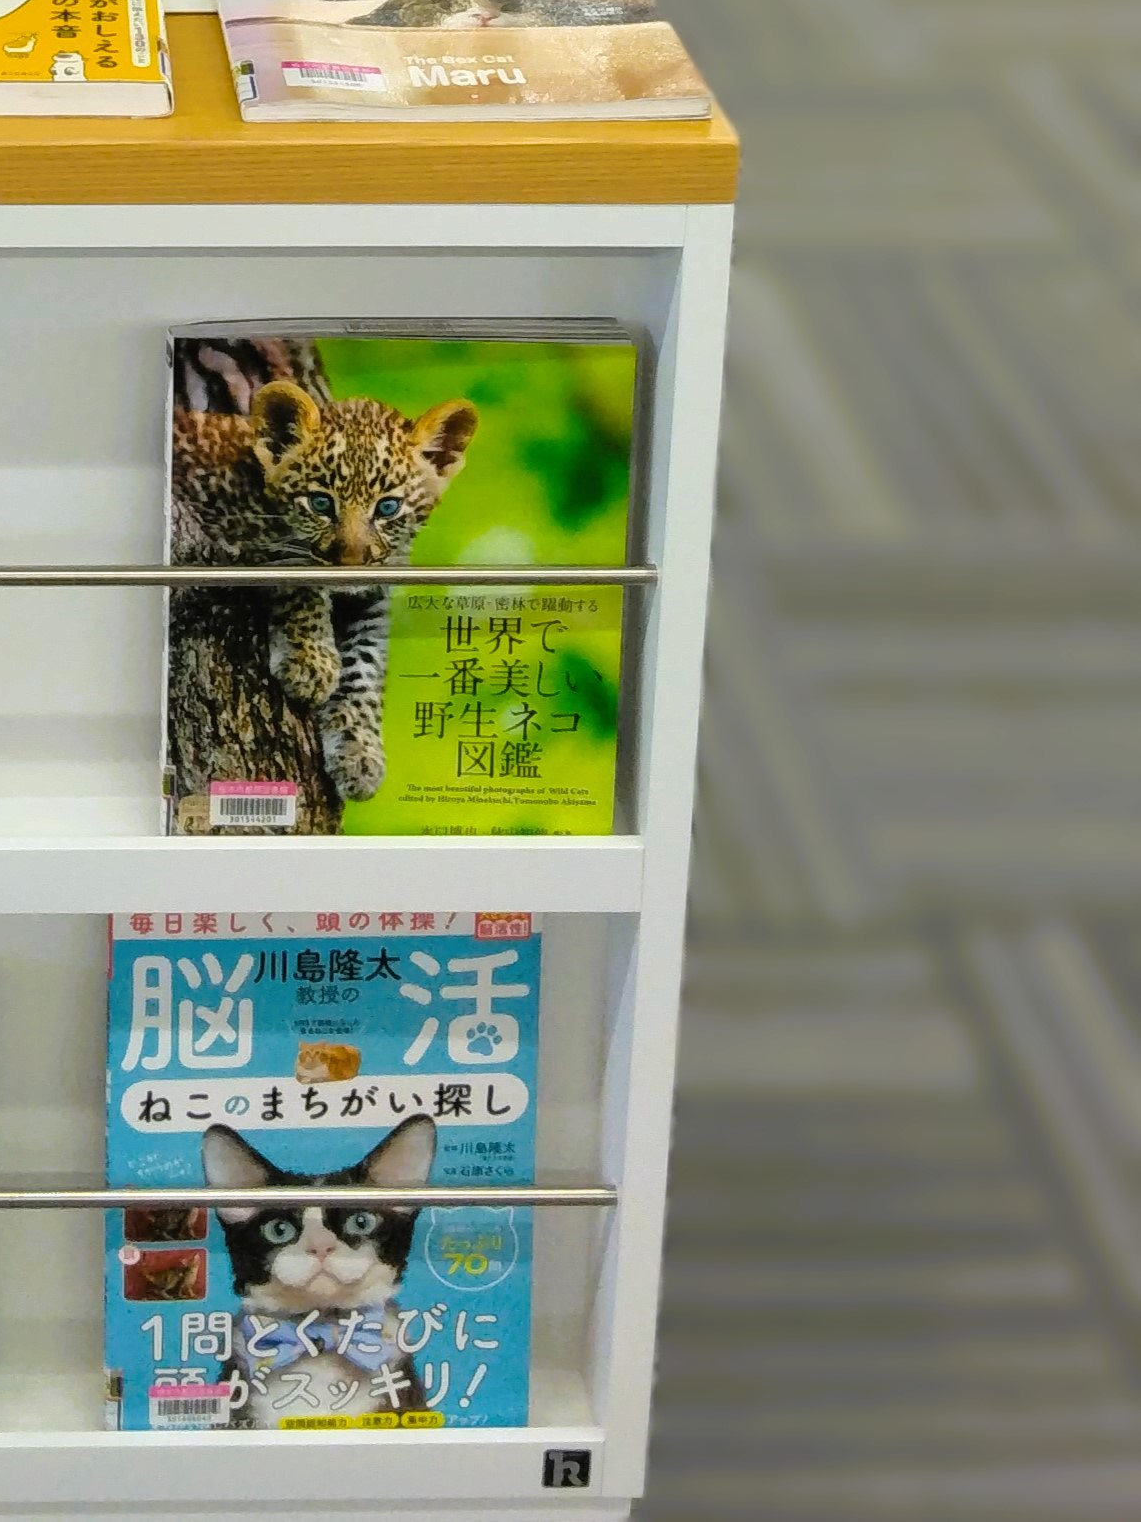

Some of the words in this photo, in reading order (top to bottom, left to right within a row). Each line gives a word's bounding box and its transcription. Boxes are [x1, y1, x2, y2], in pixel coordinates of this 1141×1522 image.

[402, 56, 437, 65] The
[481, 55, 515, 63] Cat
[408, 65, 527, 87] Maru
[440, 615, 569, 654] 世界で
[399, 657, 603, 698] 一番美しい
[414, 701, 581, 741] 野生ネコ
[457, 741, 543, 779] 図鑑
[254, 948, 403, 984] 川島隆太
[295, 985, 360, 1006] 教授の
[138, 1083, 512, 1122] ねこのまちがい探し
[140, 1303, 500, 1363] 1問とくたびに
